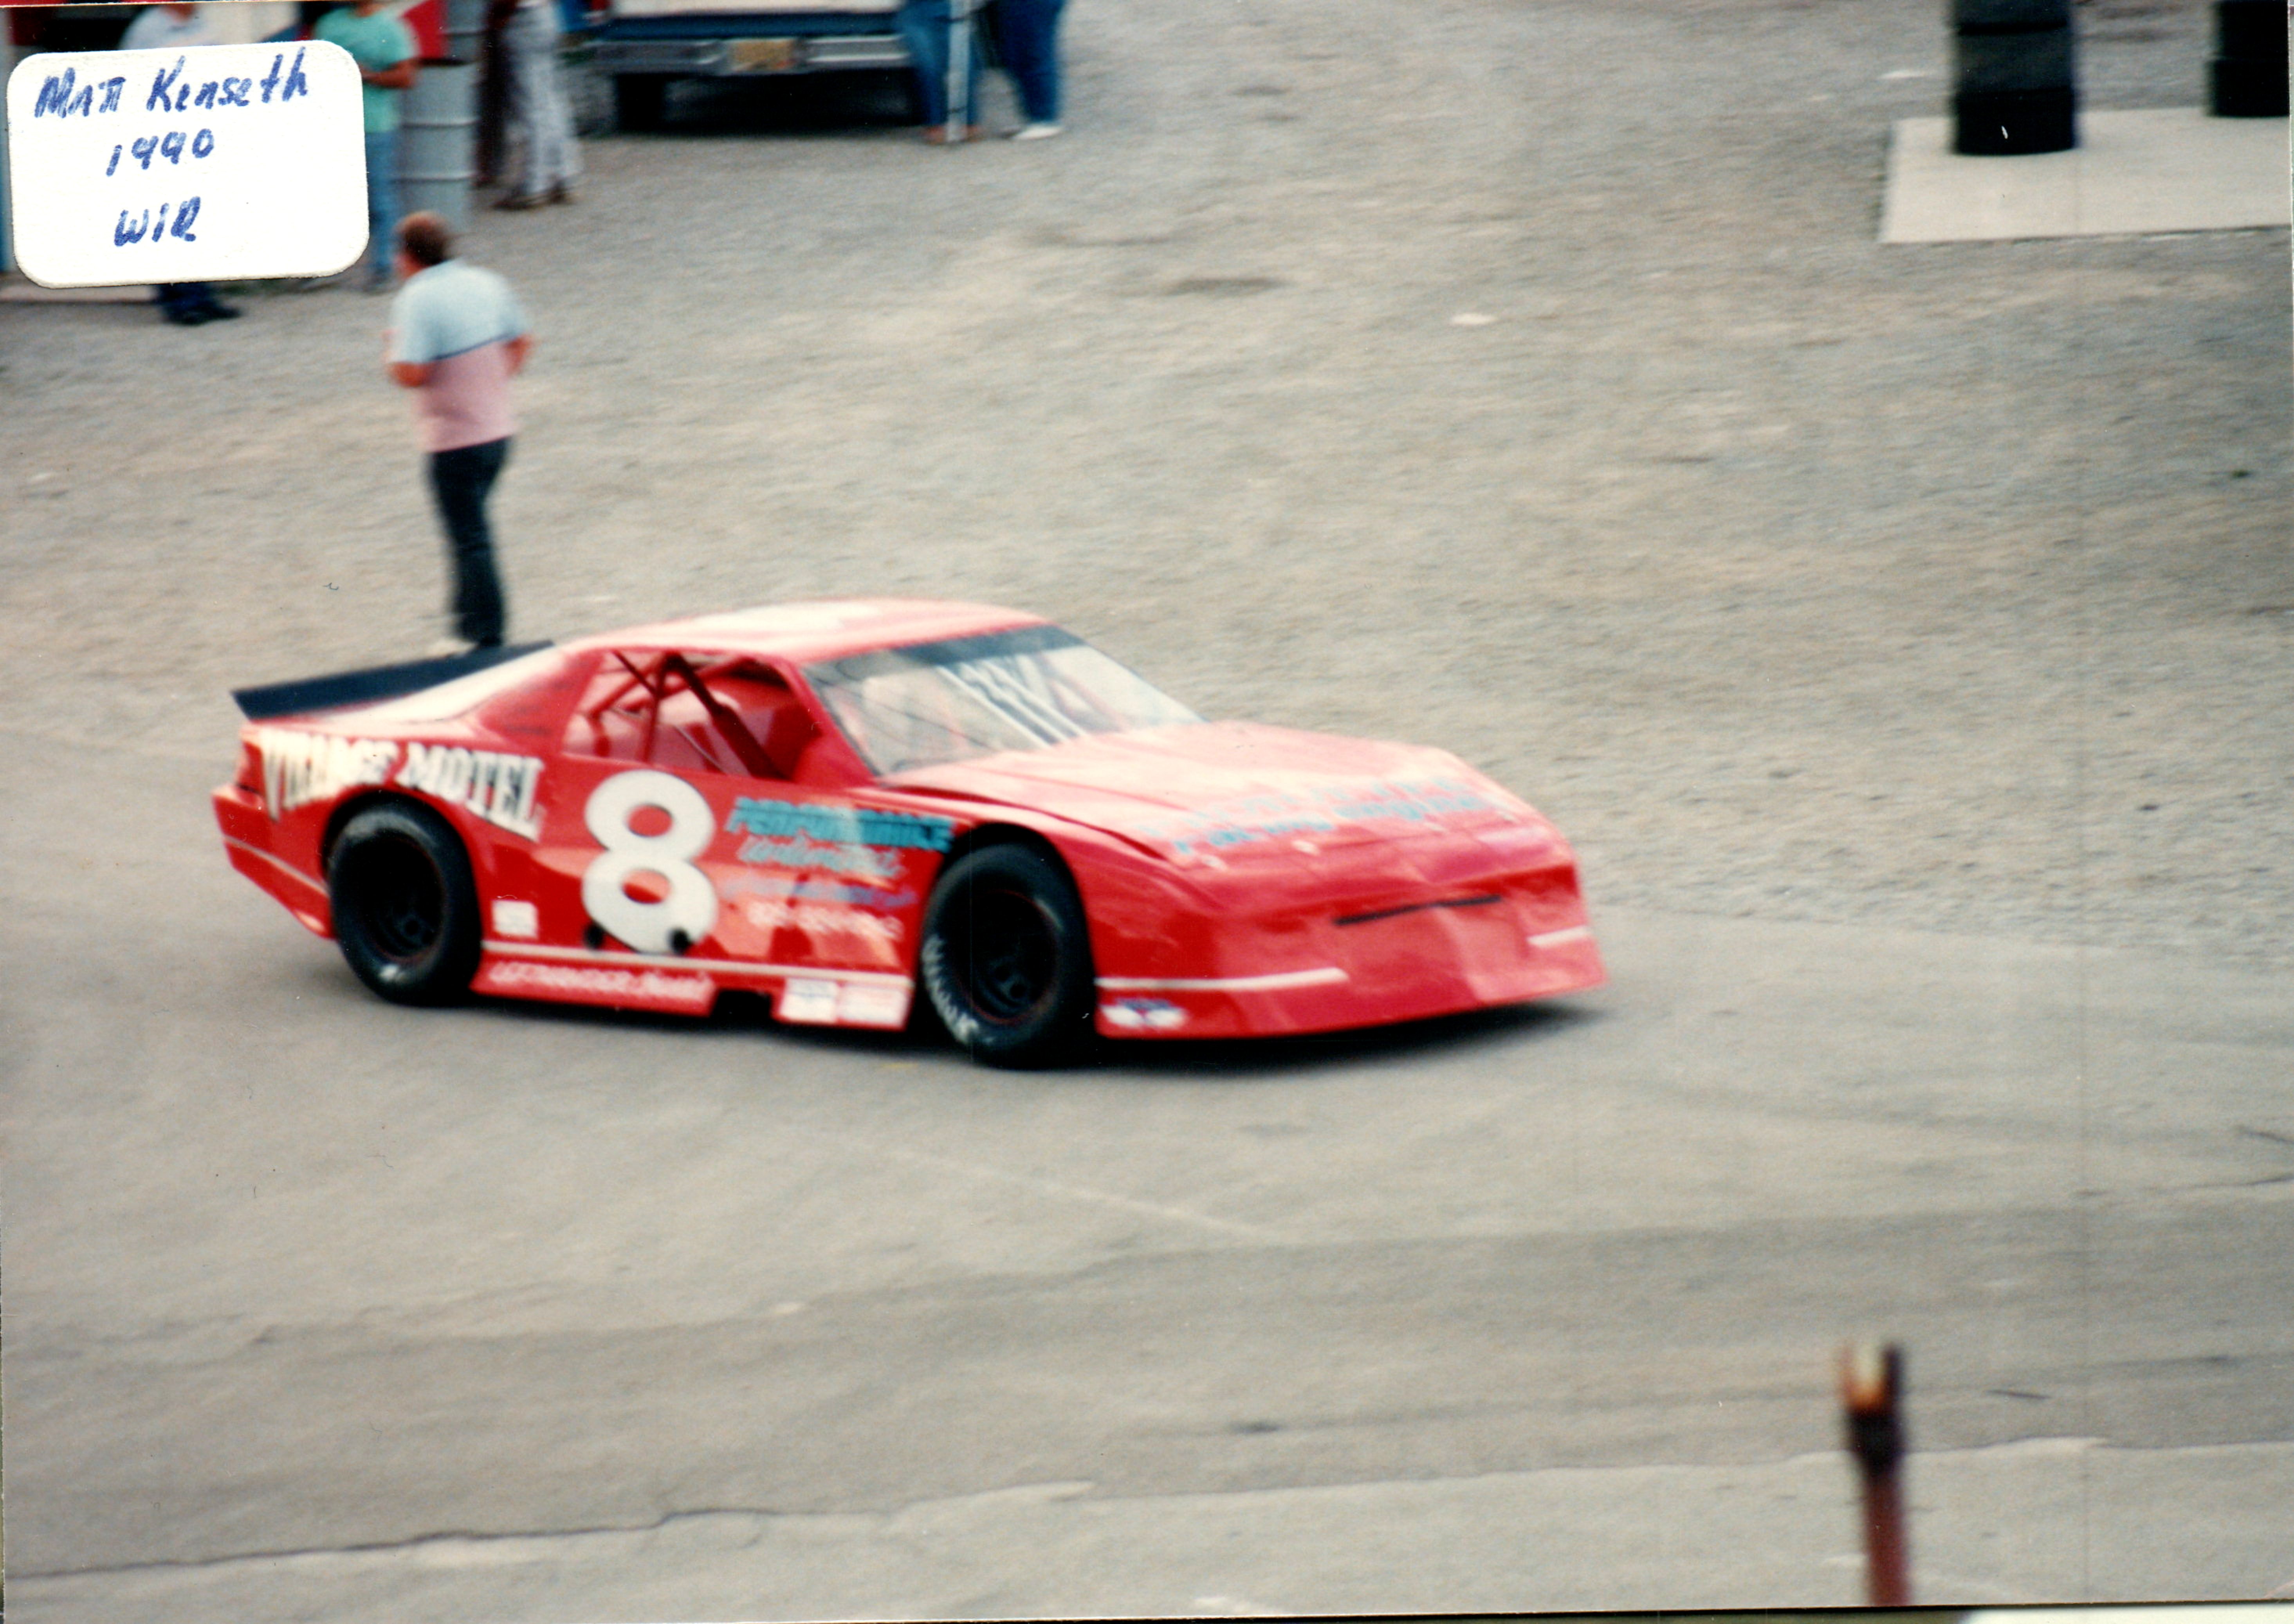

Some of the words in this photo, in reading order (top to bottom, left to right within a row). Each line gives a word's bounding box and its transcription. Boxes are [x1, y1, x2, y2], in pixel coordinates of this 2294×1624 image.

[146, 46, 308, 112] Kenseth
[105, 128, 215, 177] 1990
[395, 741, 544, 843] MOTEL
[581, 769, 719, 955] 8
